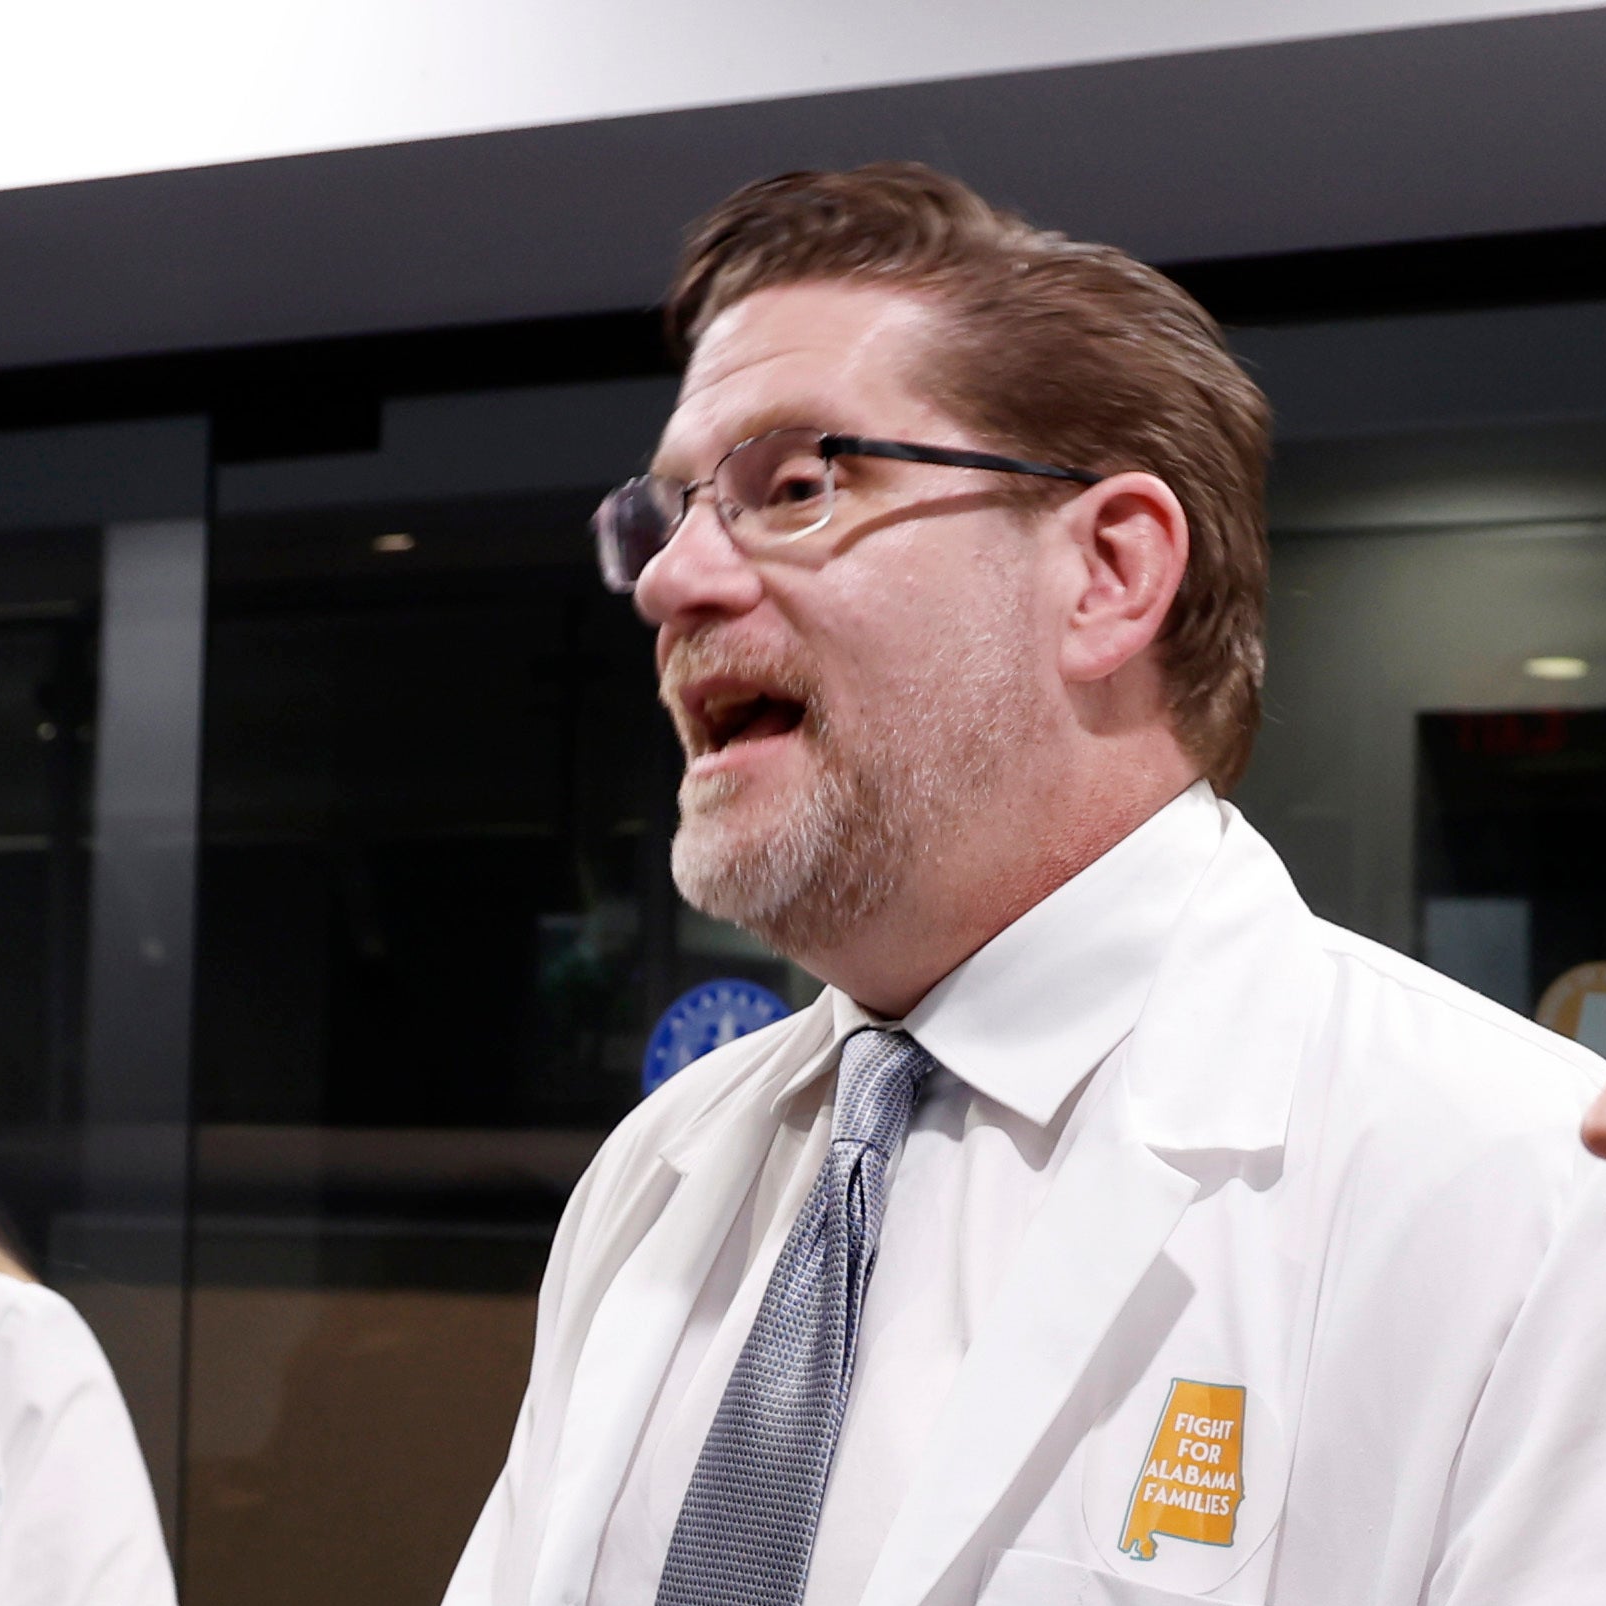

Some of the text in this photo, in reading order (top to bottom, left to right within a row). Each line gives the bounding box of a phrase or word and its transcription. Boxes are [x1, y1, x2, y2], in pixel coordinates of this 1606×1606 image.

[1175, 1414, 1234, 1439] FIGHT
[1178, 1439, 1221, 1463] FOR
[1145, 1460, 1235, 1490] ALABAMA
[1144, 1484, 1229, 1515] FAMILIES
